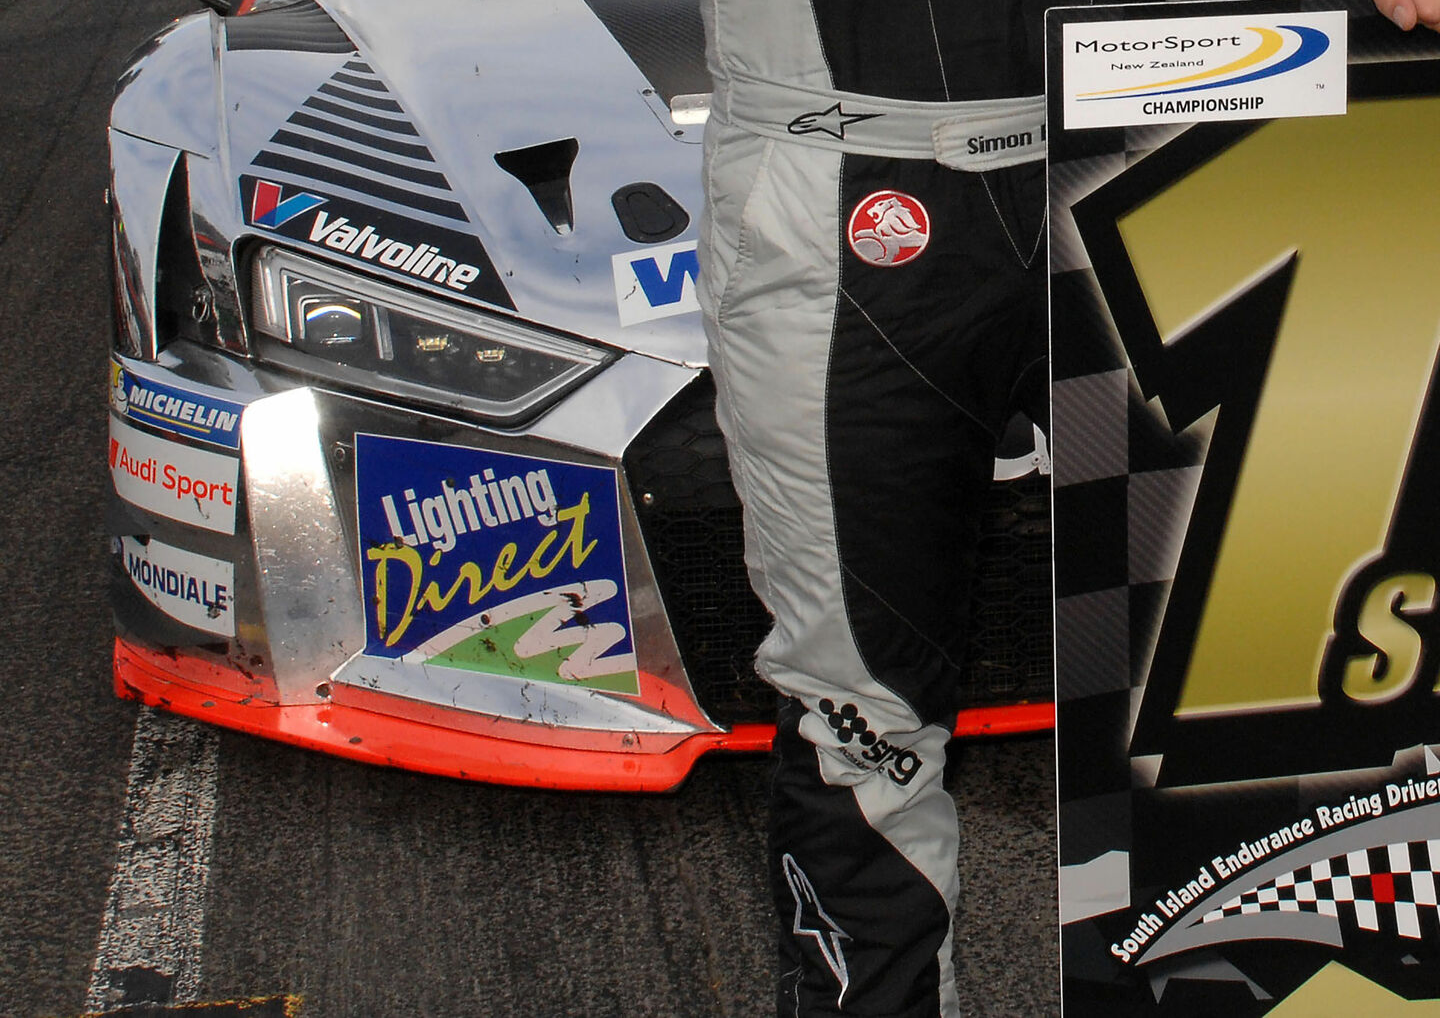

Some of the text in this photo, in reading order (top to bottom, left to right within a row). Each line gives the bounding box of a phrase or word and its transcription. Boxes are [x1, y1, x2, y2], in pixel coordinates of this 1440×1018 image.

[1075, 35, 1241, 54] MotorSport
[1111, 59, 1204, 71] New Zealand
[1142, 97, 1264, 115] CHAMPIONSHIP
[967, 131, 1032, 155] Simon
[309, 210, 481, 291] Valvoline
[129, 385, 239, 432] MICHELIN
[119, 447, 234, 506] Audi Sport
[381, 468, 559, 553] Lighting
[128, 553, 228, 612] MONDIALE
[367, 491, 598, 647] Direct
[1111, 913, 1163, 963] South
[1165, 867, 1216, 920] Island
[1211, 817, 1315, 878] Endurance
[1316, 793, 1384, 829] Racing
